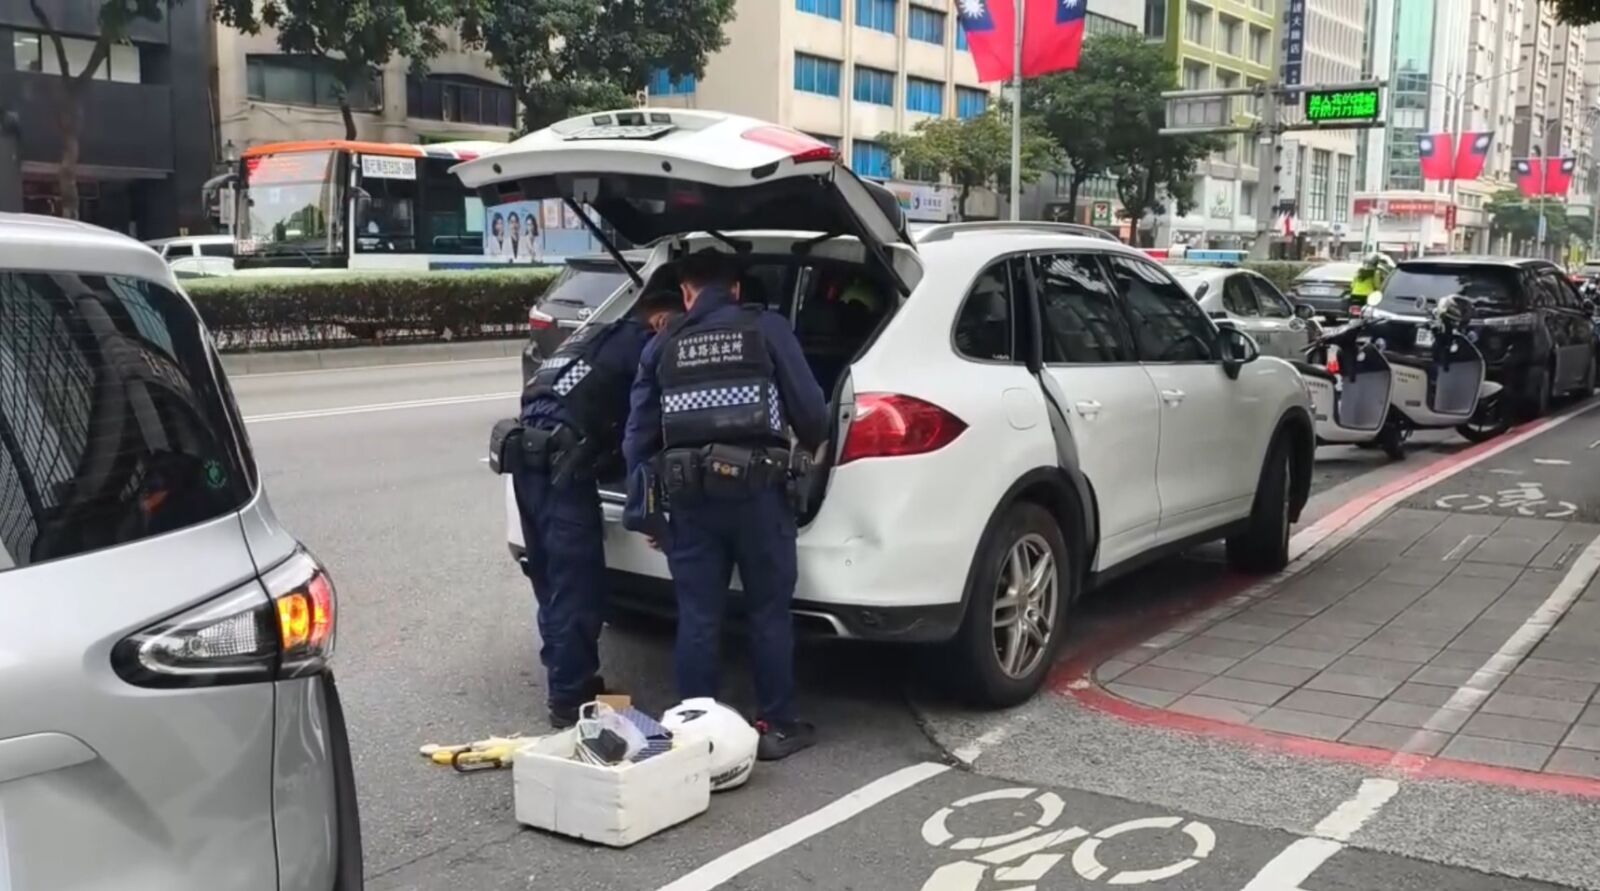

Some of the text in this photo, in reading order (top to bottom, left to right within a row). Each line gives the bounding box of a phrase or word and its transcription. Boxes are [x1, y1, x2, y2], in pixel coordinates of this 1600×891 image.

[677, 340, 743, 360] 長春路派出所
[722, 354, 743, 362] Police
